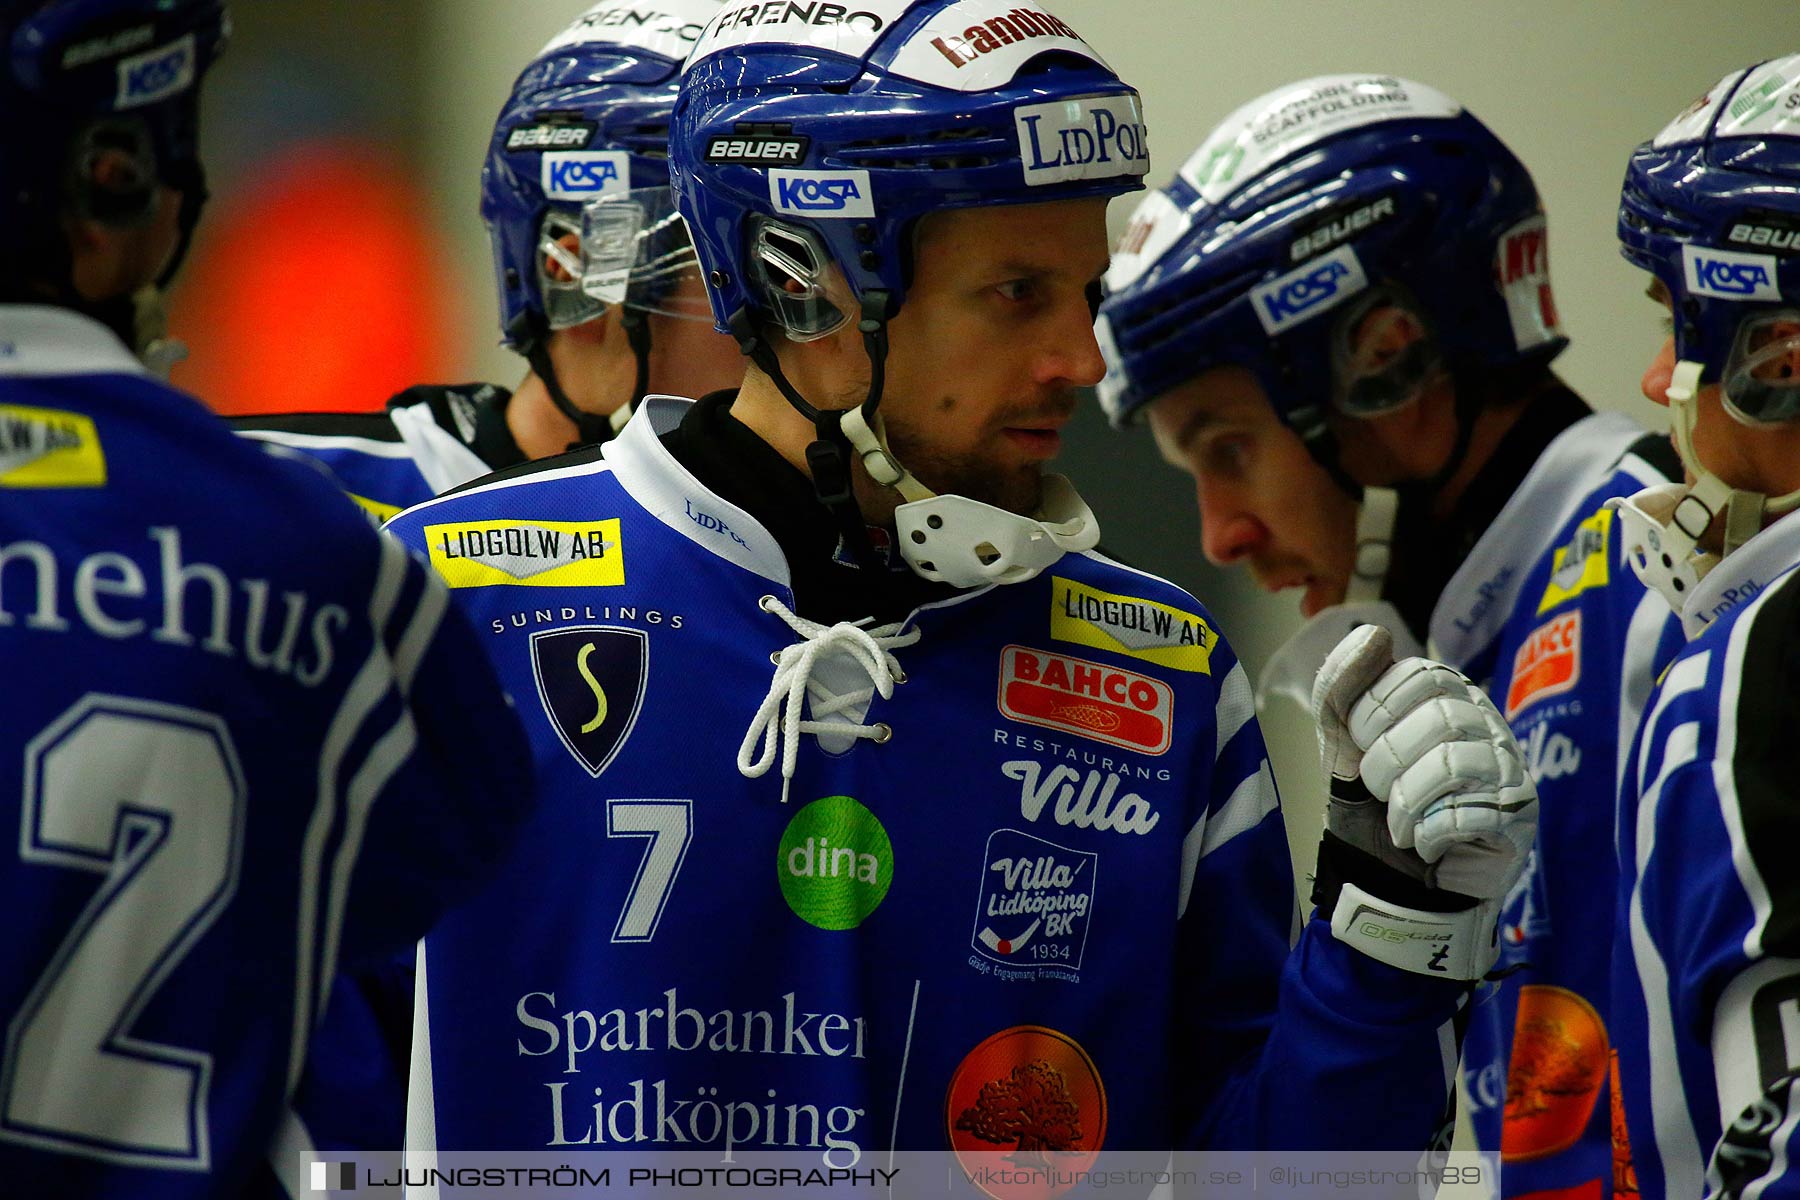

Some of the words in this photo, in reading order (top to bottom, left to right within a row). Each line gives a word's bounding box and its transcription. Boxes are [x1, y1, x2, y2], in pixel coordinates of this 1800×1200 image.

[507, 128, 589, 147] BAUER
[709, 140, 800, 159] BAUER
[551, 160, 618, 192] KOSA
[777, 178, 861, 210] KOSA
[1290, 198, 1394, 261] BAUER
[1264, 261, 1348, 322] KOSA
[1694, 256, 1769, 295] KOSA
[443, 529, 560, 559] LIDGOLW
[571, 530, 605, 559] AB
[491, 607, 684, 633] SUNDLINGS
[1065, 588, 1172, 639] LIDGOLW
[1014, 652, 1159, 711] BAHCO
[993, 728, 1171, 781] RESTAURANG
[1001, 760, 1160, 836] Villa
[606, 799, 693, 943] 7
[787, 837, 879, 884] dina
[990, 855, 1074, 891] Villa
[987, 889, 1089, 920] Lidköping
[0, 692, 247, 1172] 2
[1045, 911, 1077, 938] BK
[1030, 943, 1070, 960] 1934
[543, 1079, 865, 1170] Lidköping
